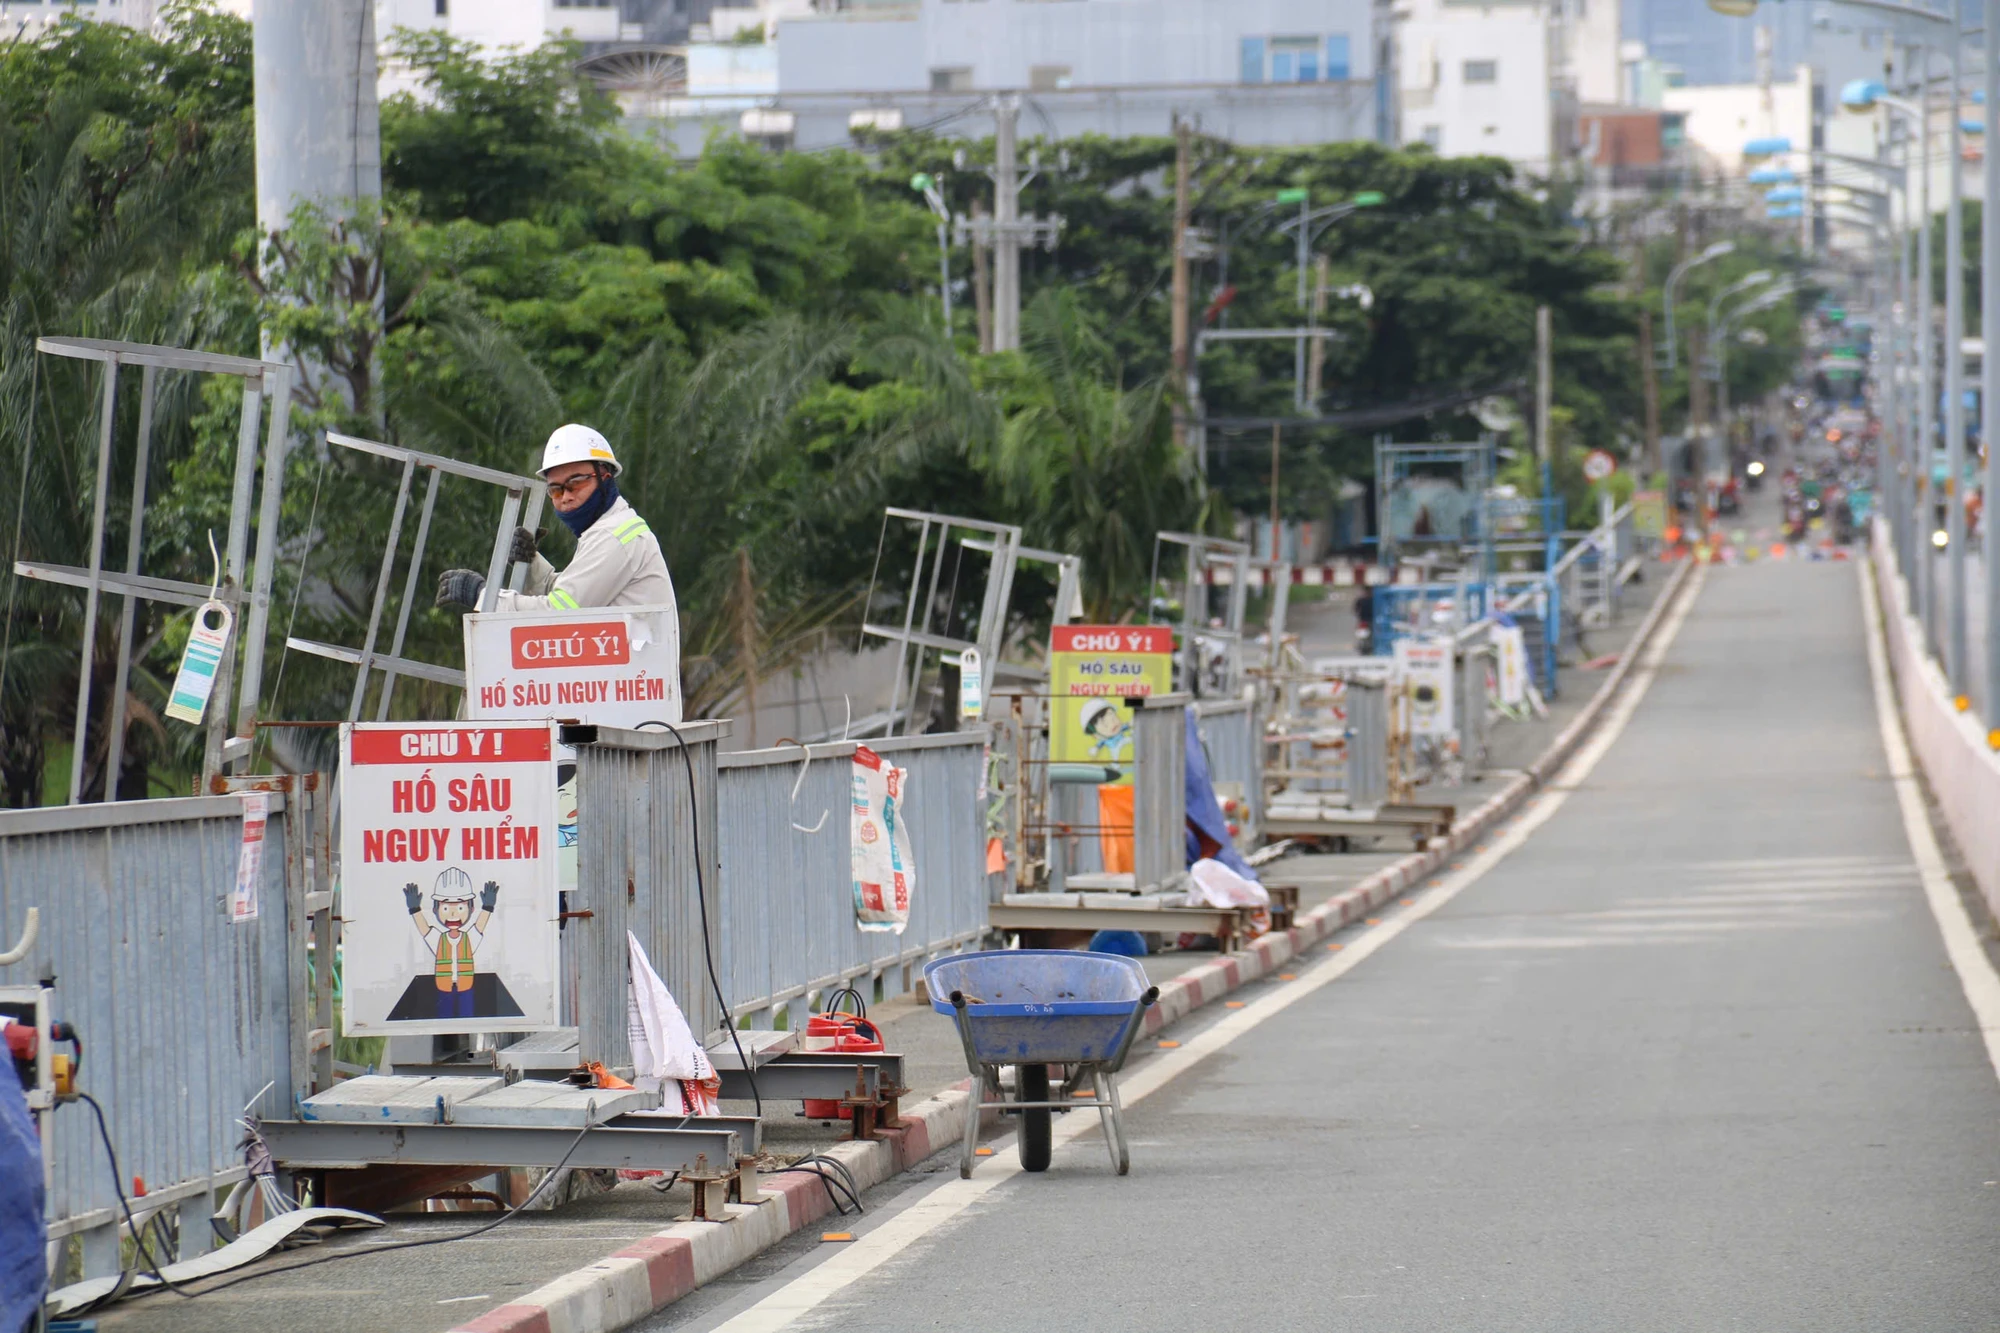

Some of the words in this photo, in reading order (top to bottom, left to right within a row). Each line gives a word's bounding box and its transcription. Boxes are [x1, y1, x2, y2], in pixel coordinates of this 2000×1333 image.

[521, 631, 585, 660] CHÚ
[1071, 631, 1121, 651] CHÚ
[481, 677, 506, 708] HỐ
[513, 679, 551, 706] SÂU
[557, 680, 609, 704] NGUY
[615, 669, 664, 701] HIỂM
[1070, 683, 1110, 696] NGUY
[400, 730, 459, 757] CHÚ
[392, 768, 436, 813] HỐ
[448, 773, 511, 812] SÂU
[363, 828, 450, 863] NGUY
[461, 814, 538, 860] HIỂM
